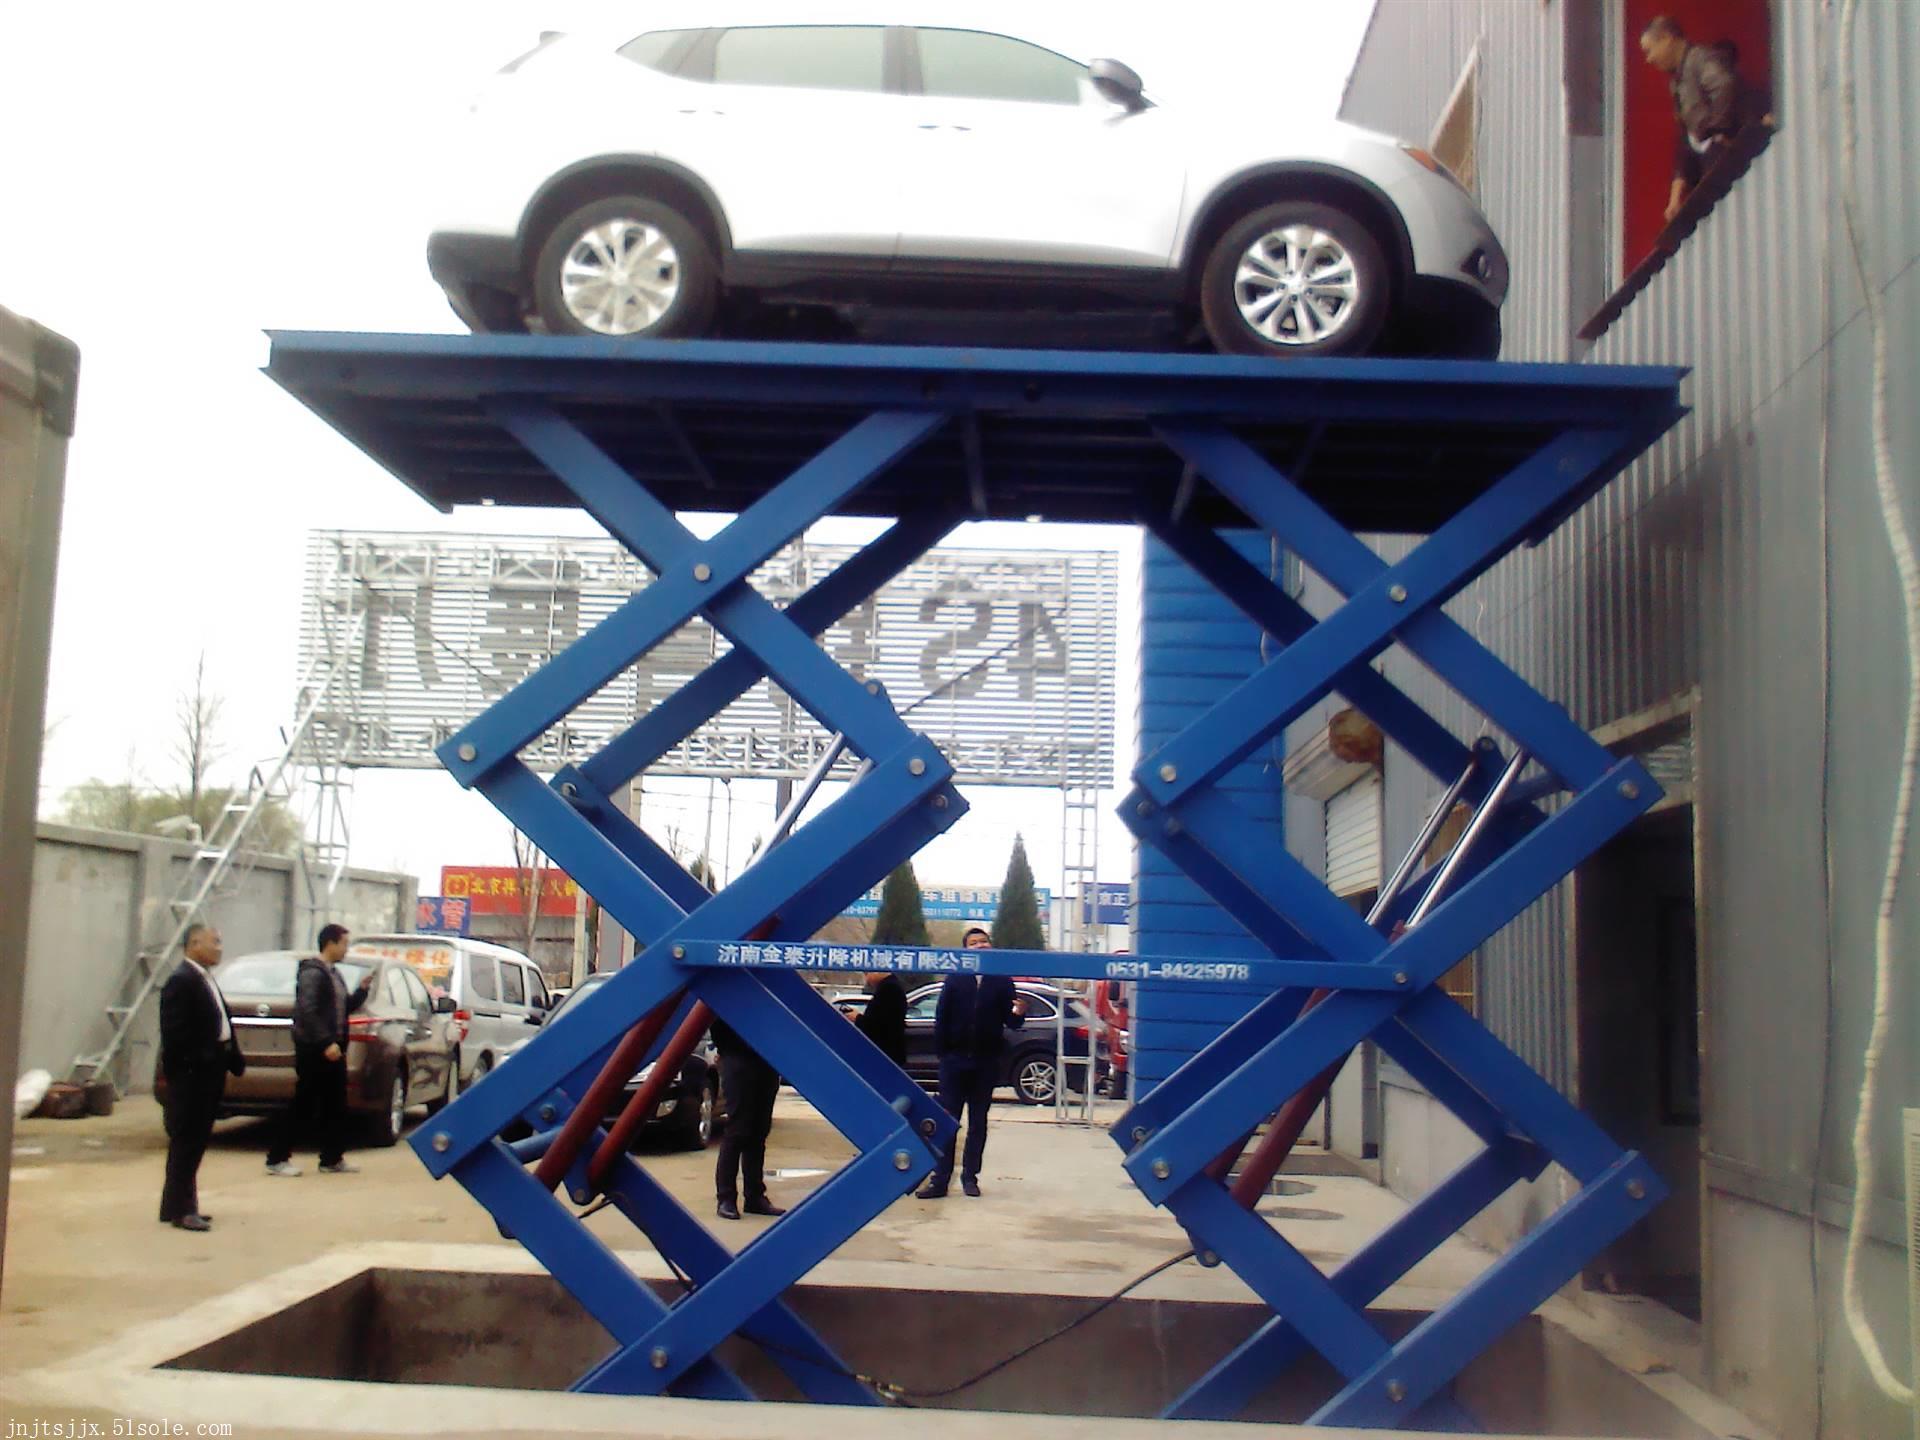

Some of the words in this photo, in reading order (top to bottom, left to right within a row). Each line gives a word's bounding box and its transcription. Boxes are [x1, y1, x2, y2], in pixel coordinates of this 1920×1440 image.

[718, 943, 980, 971] 济南金泰升降机械有限公司
[1106, 961, 1249, 979] 0531-84225978
